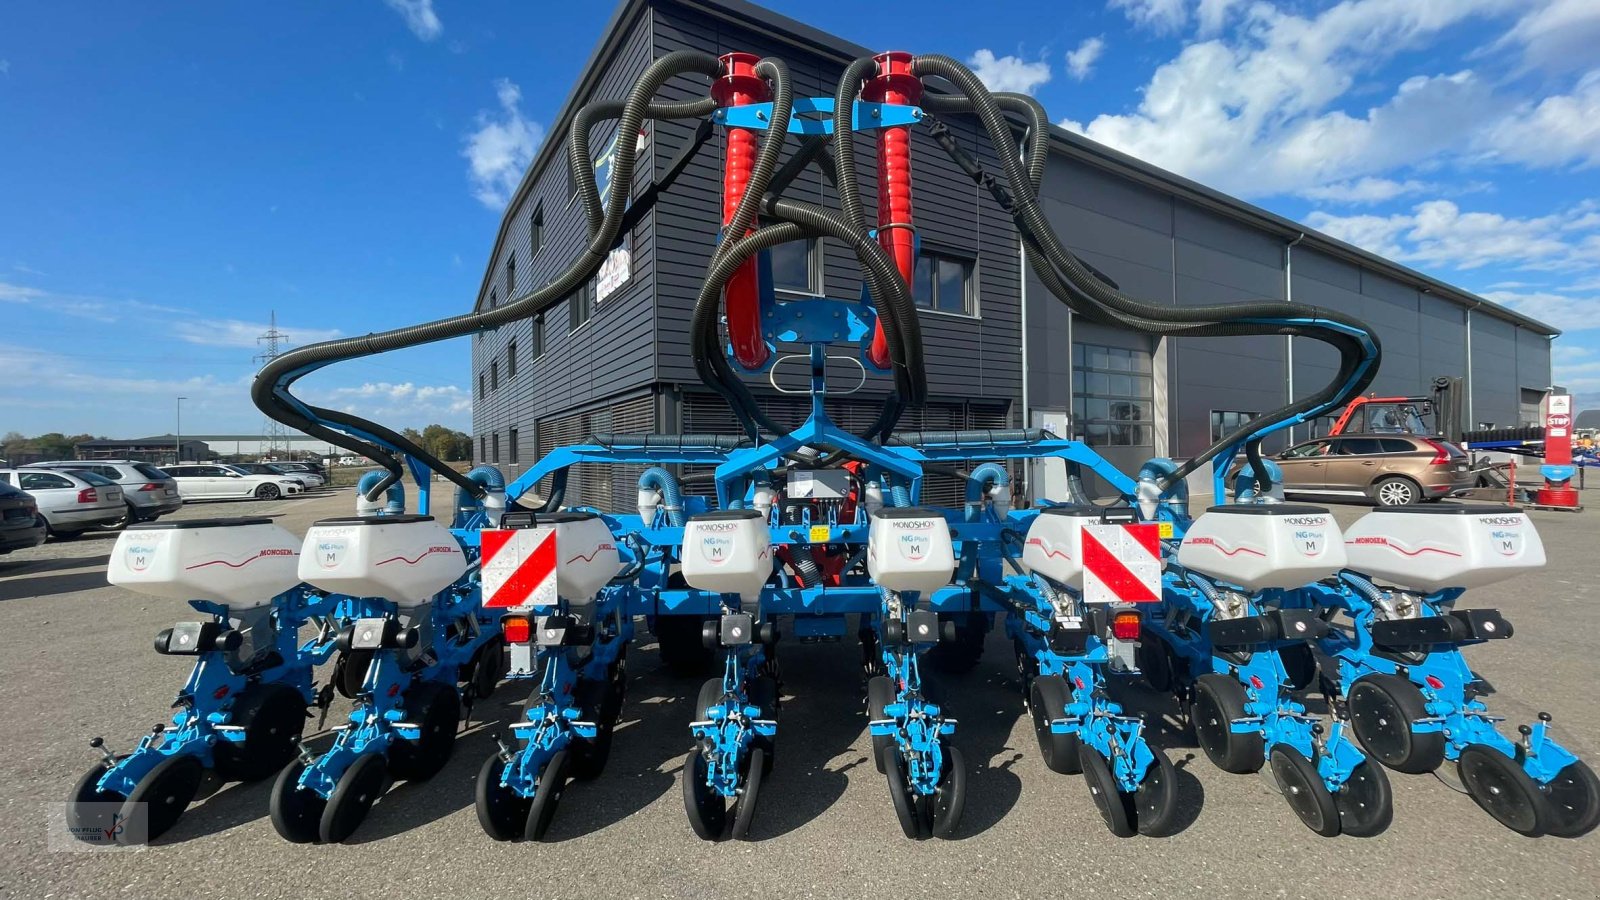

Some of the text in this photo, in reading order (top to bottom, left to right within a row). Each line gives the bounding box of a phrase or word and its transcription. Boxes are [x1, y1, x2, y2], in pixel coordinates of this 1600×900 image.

[1549, 417, 1569, 425] STOP
[892, 520, 935, 529] MONOSHOX
[1283, 517, 1327, 525] MONOSHOX
[1479, 517, 1522, 525] MONOSHOX
[696, 522, 738, 531] MONOSHOX
[1295, 531, 1308, 539] NG
[1354, 537, 1388, 545] MONOSEM
[911, 545, 920, 554] M
[1306, 541, 1316, 550] M
[1502, 541, 1513, 550] M
[259, 549, 293, 557] MONOSEM
[712, 547, 722, 556] M
[136, 556, 145, 566] M
[327, 553, 336, 561] M
